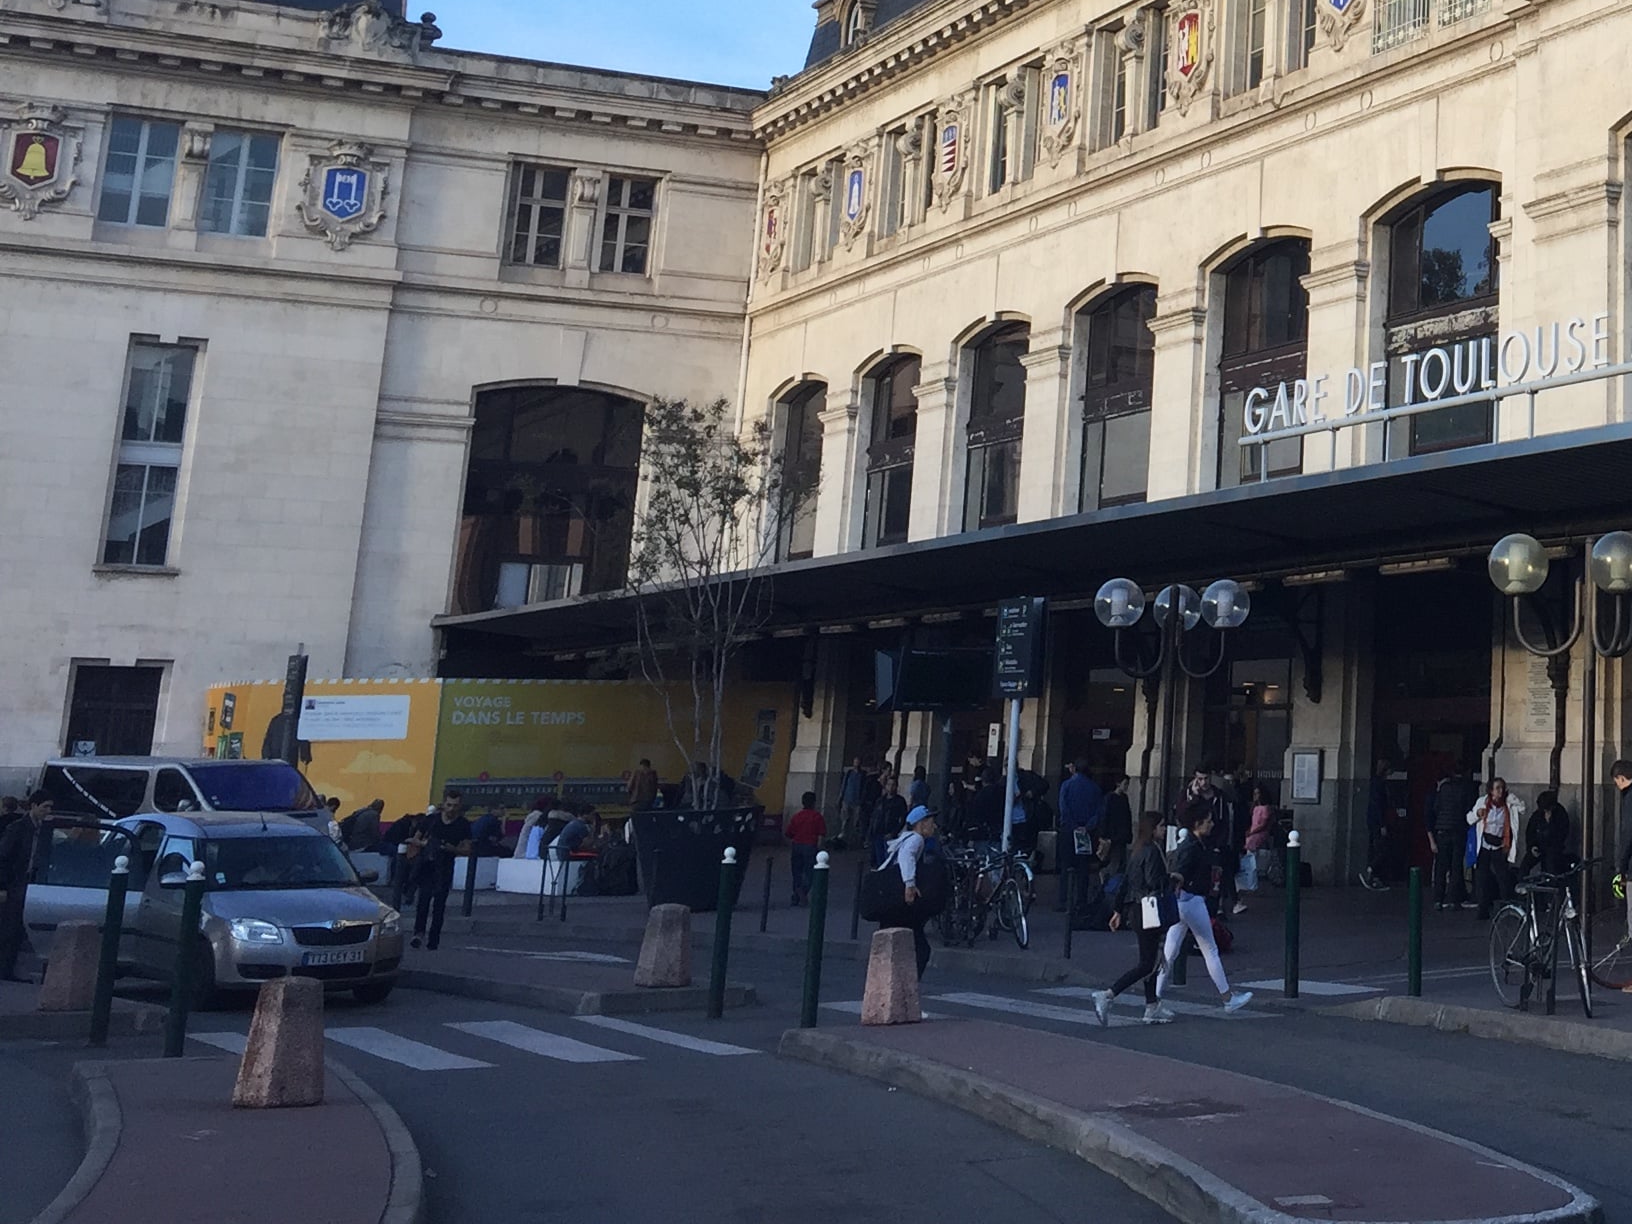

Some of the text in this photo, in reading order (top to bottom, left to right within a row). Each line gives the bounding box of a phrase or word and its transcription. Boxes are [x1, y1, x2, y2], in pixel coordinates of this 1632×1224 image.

[1244, 374, 1330, 434] GARE
[1345, 363, 1387, 415] DE
[1401, 312, 1610, 405] TOULOUSE
[453, 696, 512, 708] VOYAGE
[451, 710, 586, 726] DANS LE TEMPS
